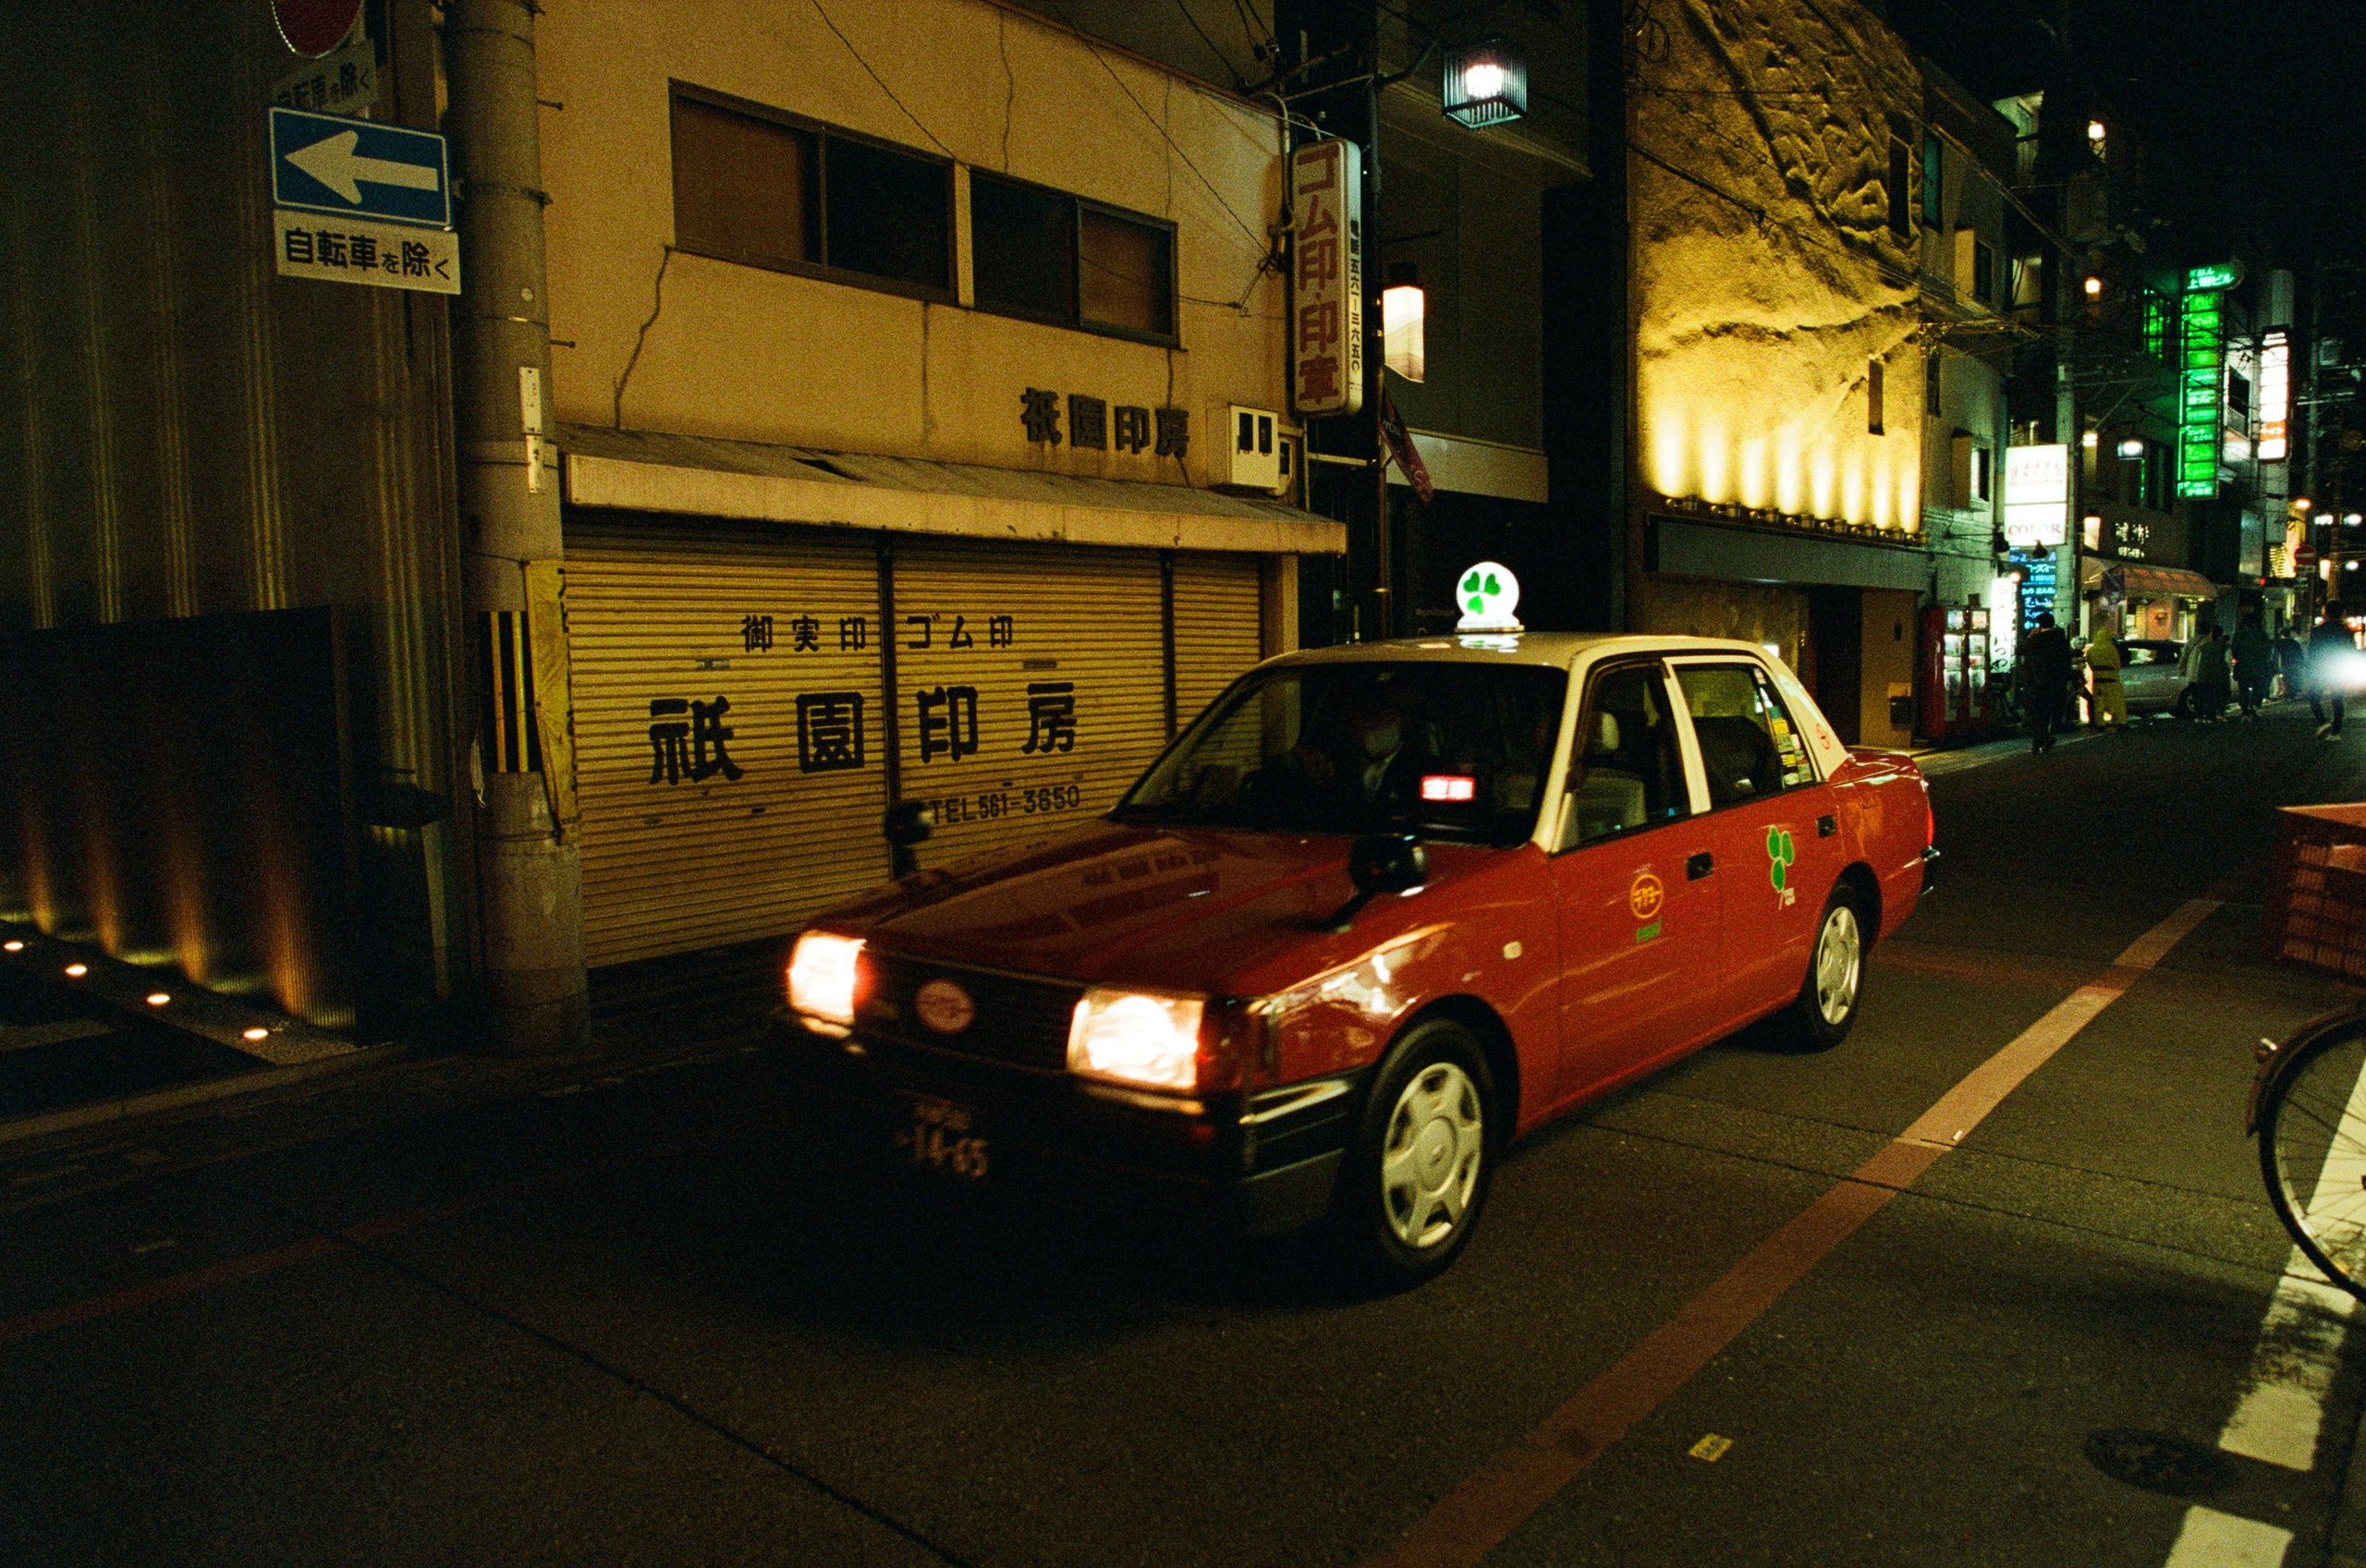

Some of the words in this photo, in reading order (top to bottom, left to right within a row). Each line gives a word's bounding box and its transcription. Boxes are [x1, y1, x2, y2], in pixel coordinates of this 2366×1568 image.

[285, 228, 450, 281] 自転車を除く
[2008, 523, 2061, 536] COLOR
[740, 614, 866, 652] 御実印
[907, 613, 1013, 649] ゴム印
